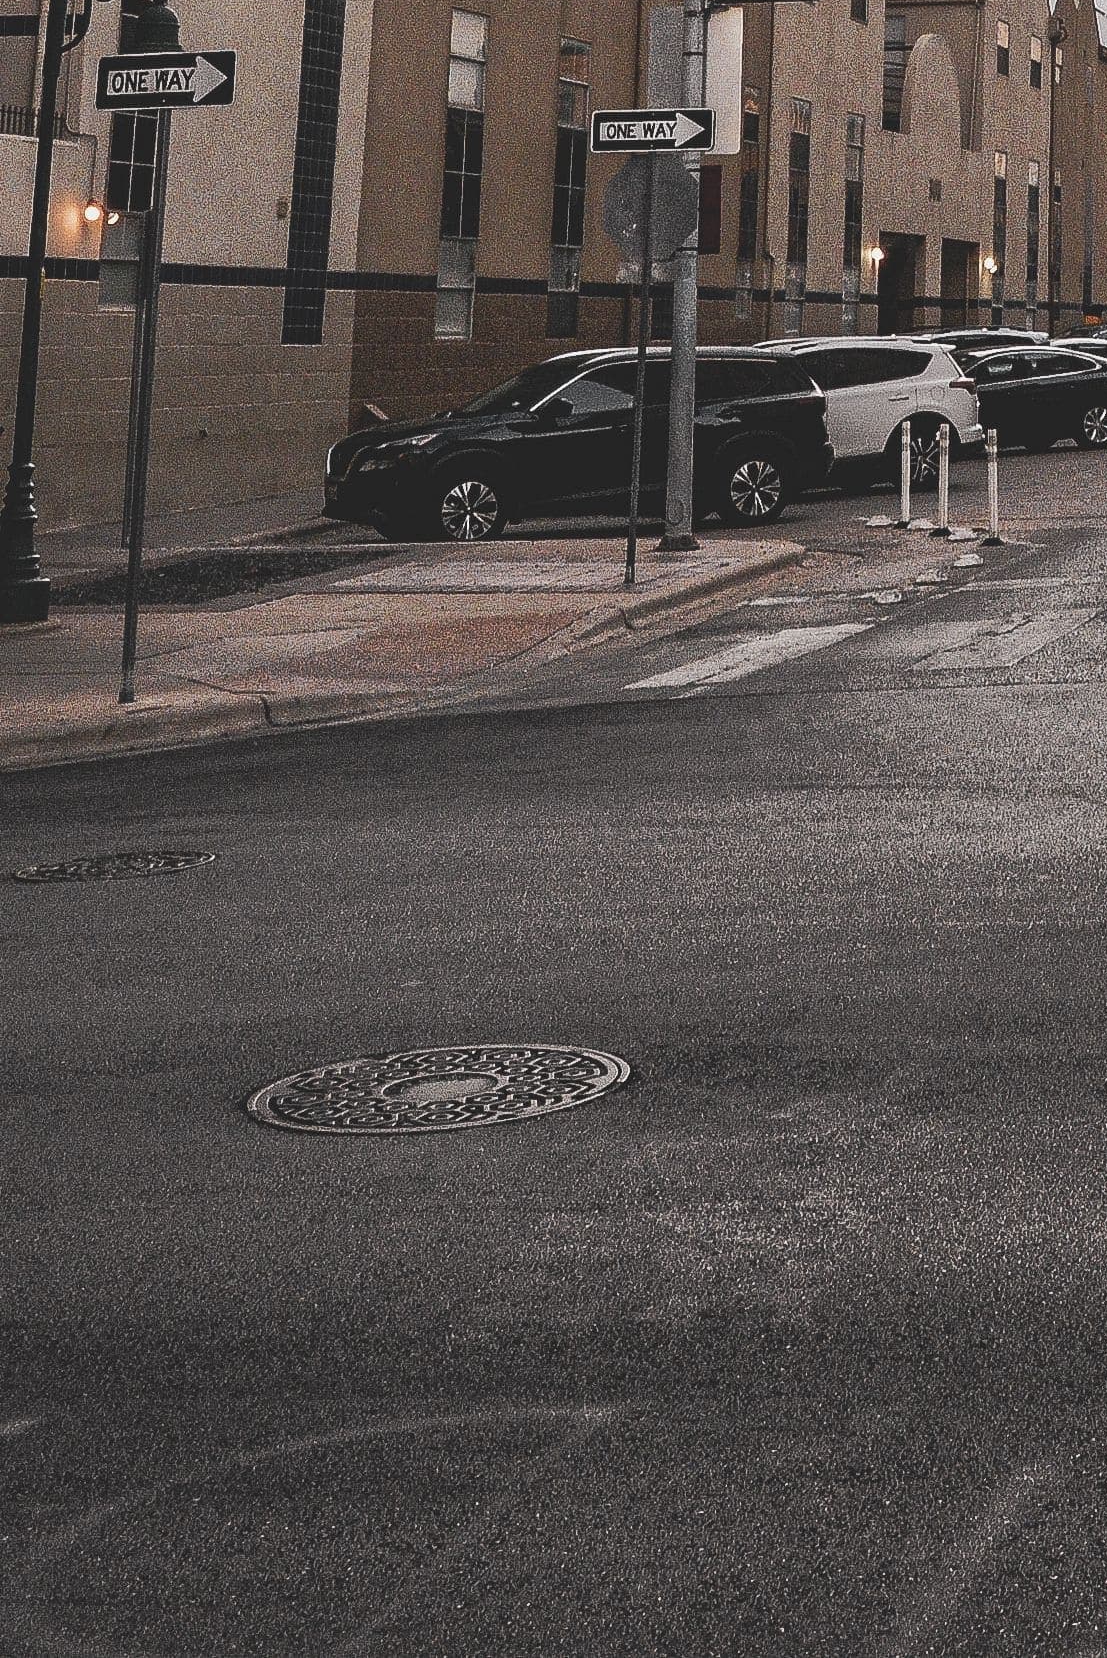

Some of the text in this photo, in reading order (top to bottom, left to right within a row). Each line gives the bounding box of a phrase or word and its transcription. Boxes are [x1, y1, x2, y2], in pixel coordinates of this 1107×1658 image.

[111, 69, 195, 94] ONE WAY
[606, 122, 677, 139] ONE WAY
